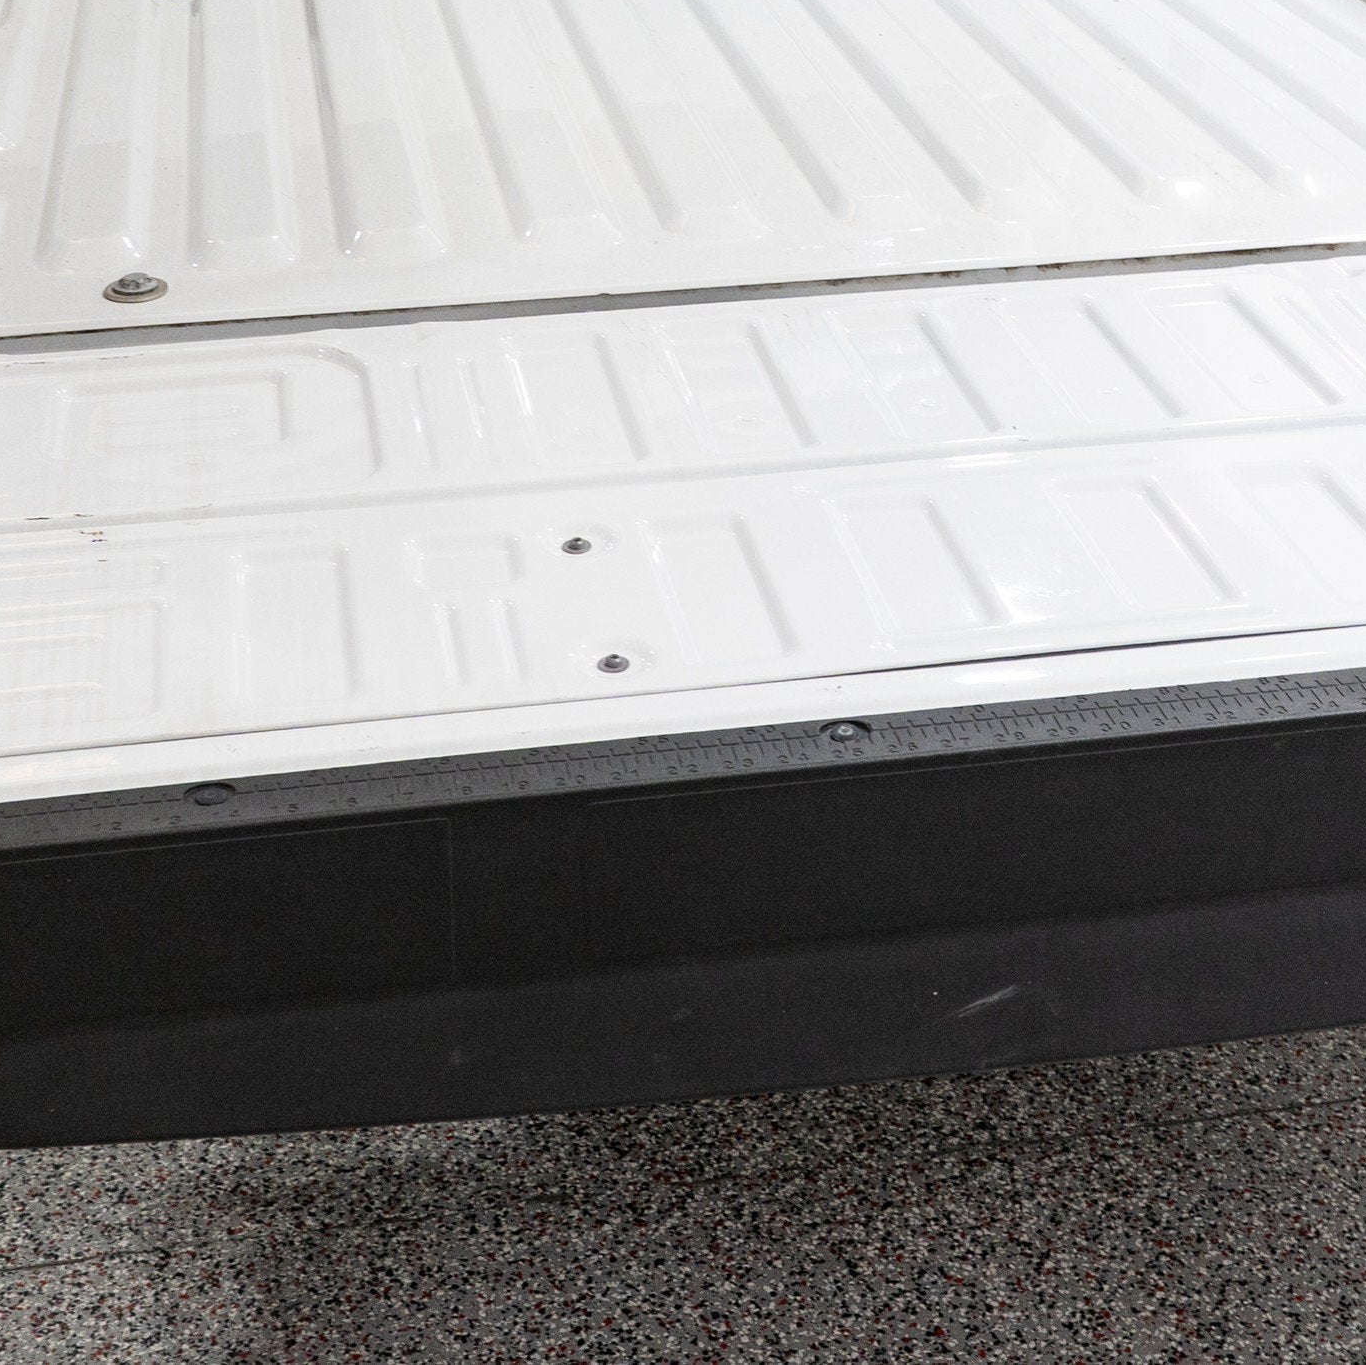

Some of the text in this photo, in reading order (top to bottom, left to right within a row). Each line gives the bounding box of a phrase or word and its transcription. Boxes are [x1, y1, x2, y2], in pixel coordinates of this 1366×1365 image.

[528, 746, 560, 756] 50
[638, 735, 670, 746] 55
[744, 725, 777, 736] 60
[952, 705, 986, 715] 70
[1054, 695, 1088, 704] 75
[1158, 685, 1189, 695] 80
[1258, 676, 1289, 685] 85
[555, 774, 587, 786] 20
[611, 769, 639, 781] 21
[666, 763, 699, 776] 22
[723, 757, 755, 770] 23
[778, 752, 809, 765] 24
[832, 747, 864, 759] 25
[886, 742, 919, 754] 26
[940, 736, 971, 748] 27
[993, 731, 1027, 743] 28
[1046, 726, 1079, 738] 29
[1100, 720, 1132, 733] 30
[1151, 716, 1181, 727] 31
[1204, 710, 1238, 722] 32
[1255, 705, 1288, 717] 33
[1306, 700, 1340, 712] 34
